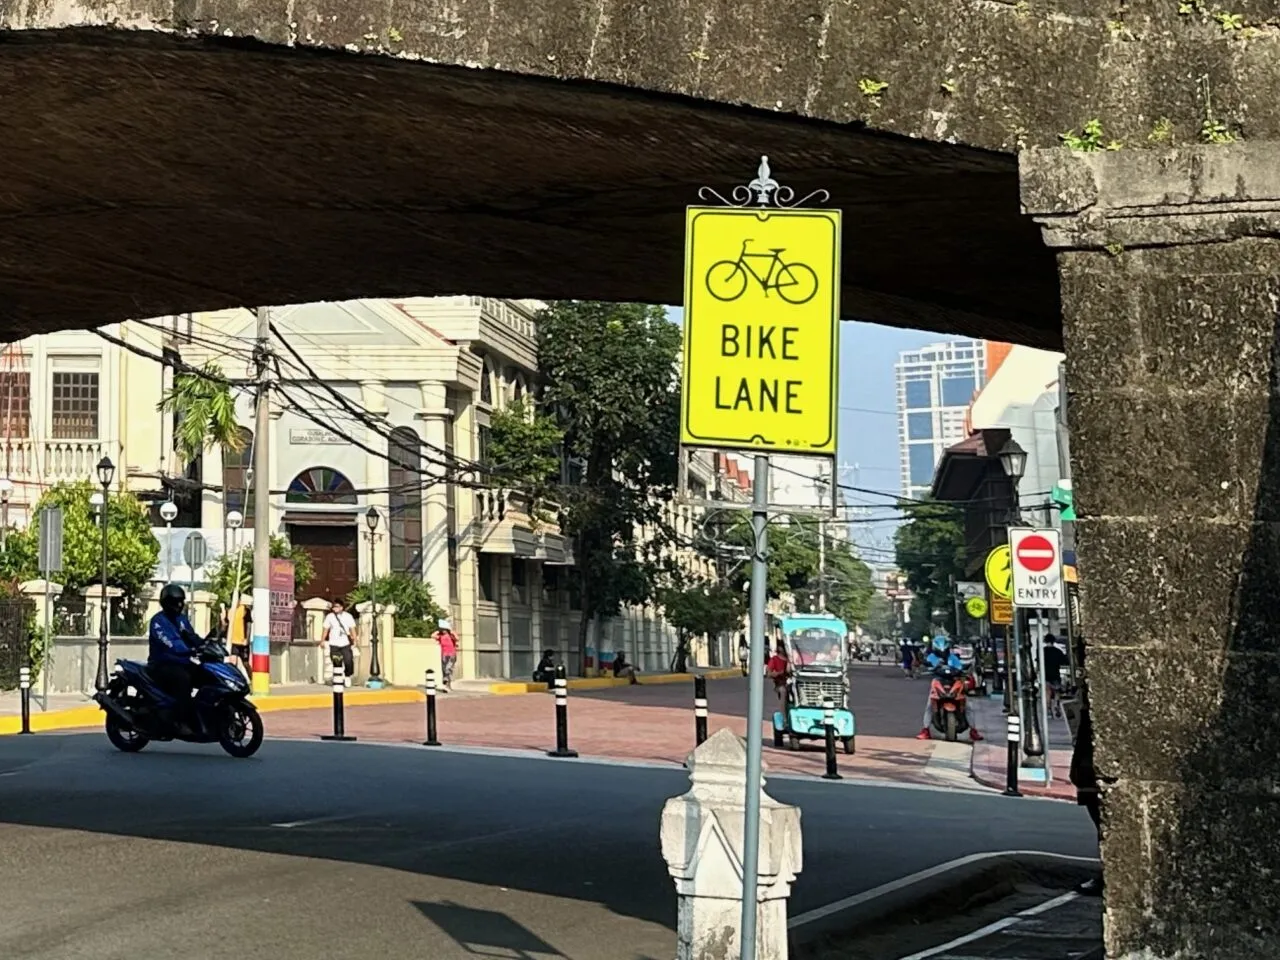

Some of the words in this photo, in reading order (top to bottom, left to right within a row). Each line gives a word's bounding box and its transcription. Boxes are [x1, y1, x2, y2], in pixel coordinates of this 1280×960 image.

[720, 324, 800, 361] BIKE
[715, 376, 803, 414] LANE
[1028, 575, 1048, 586] NO
[1018, 588, 1058, 599] ENTRY
